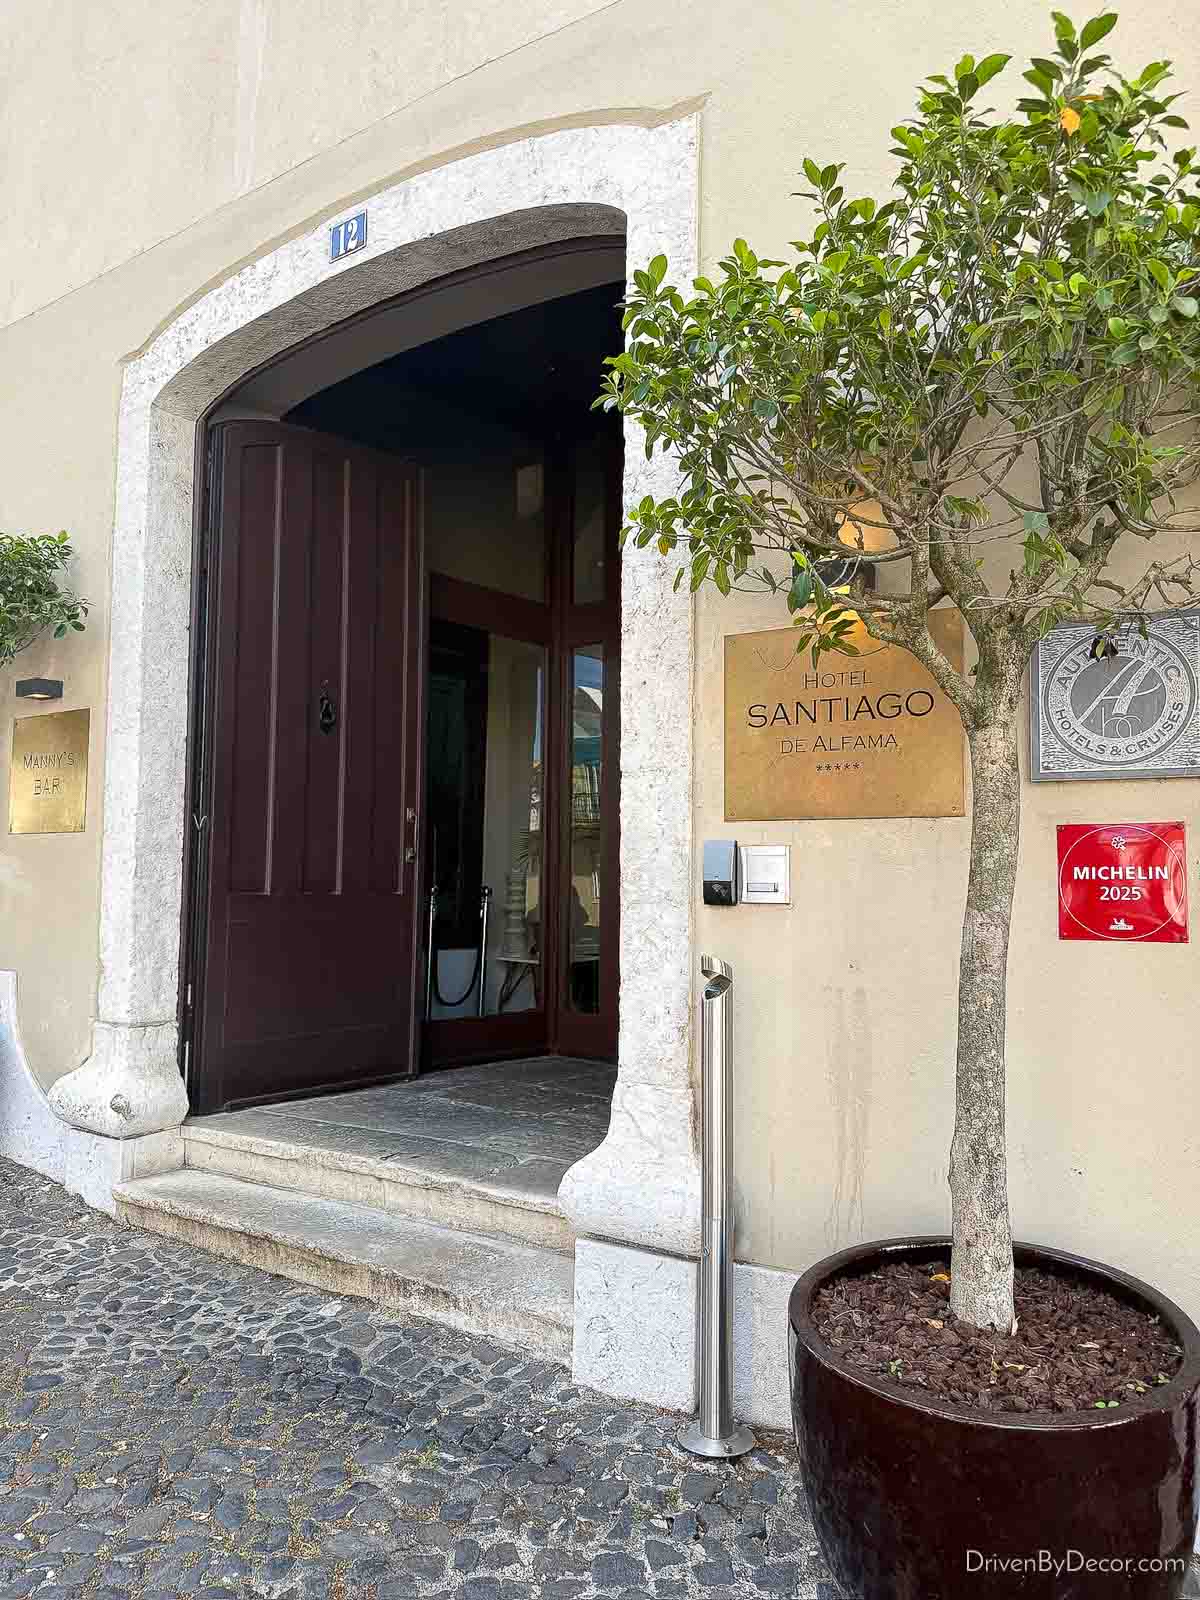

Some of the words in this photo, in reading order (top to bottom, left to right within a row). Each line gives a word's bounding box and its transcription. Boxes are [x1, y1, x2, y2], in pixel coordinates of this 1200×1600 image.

[338, 219, 359, 256] 12
[1055, 638, 1182, 691] AUTENTIC
[804, 670, 873, 689] HOTEL
[748, 690, 935, 728] SANTIAGO
[1055, 708, 1107, 756] HOTELS
[1109, 745, 1122, 756] &
[1125, 701, 1184, 755] CRUISES
[781, 739, 808, 754] DE
[812, 733, 898, 752] ALFAMA
[23, 751, 75, 769] MANNY'S
[33, 778, 61, 796] BAR
[1073, 866, 1169, 880] MICHELIN
[1099, 886, 1142, 901] 2025
